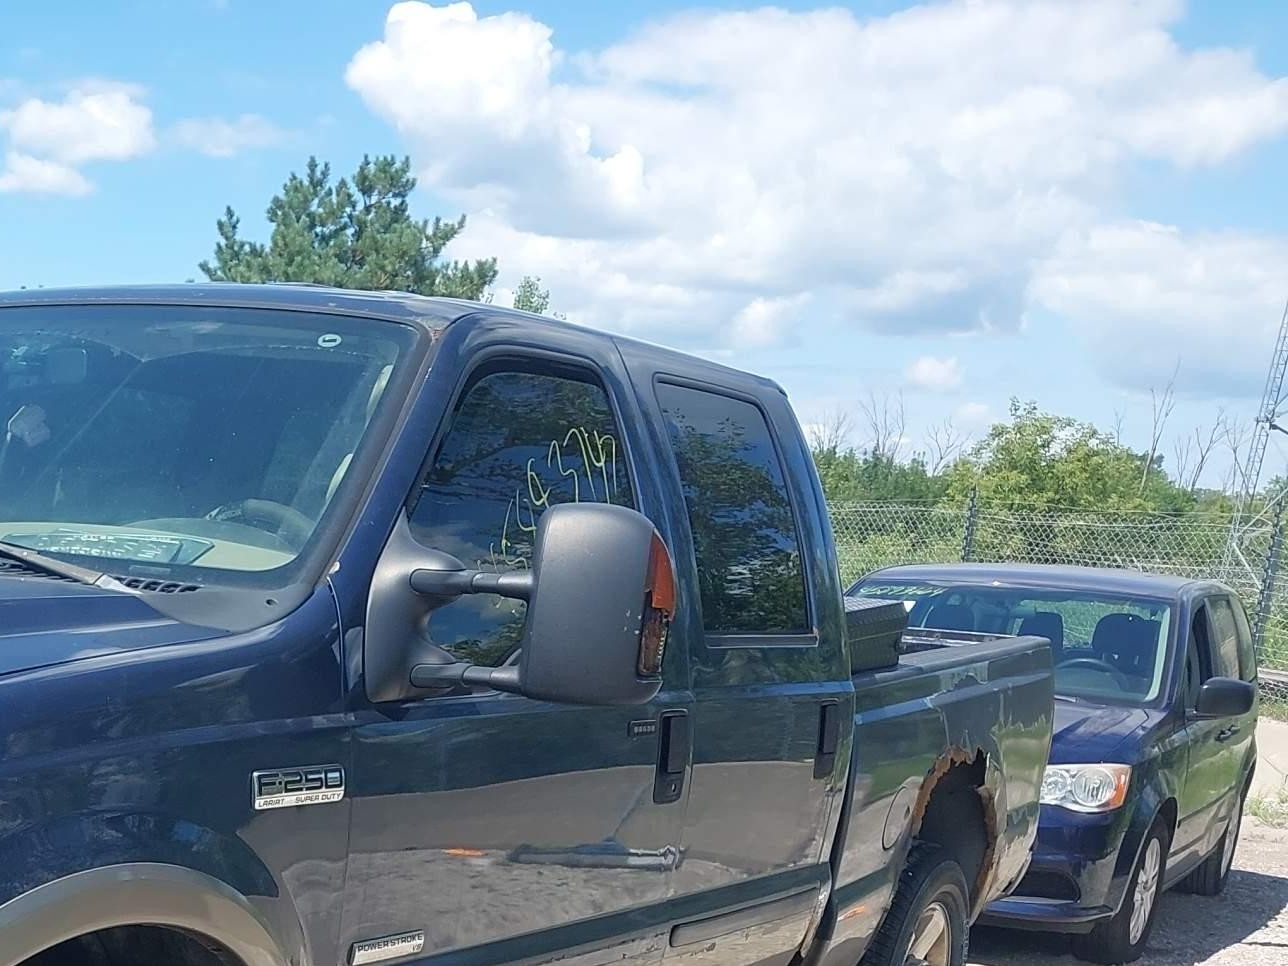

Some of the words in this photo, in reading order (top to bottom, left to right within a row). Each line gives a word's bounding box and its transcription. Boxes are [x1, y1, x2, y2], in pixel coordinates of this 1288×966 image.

[257, 797, 286, 808] LARIAT
[294, 793, 320, 804] SUPER
[321, 792, 342, 801] DUTY
